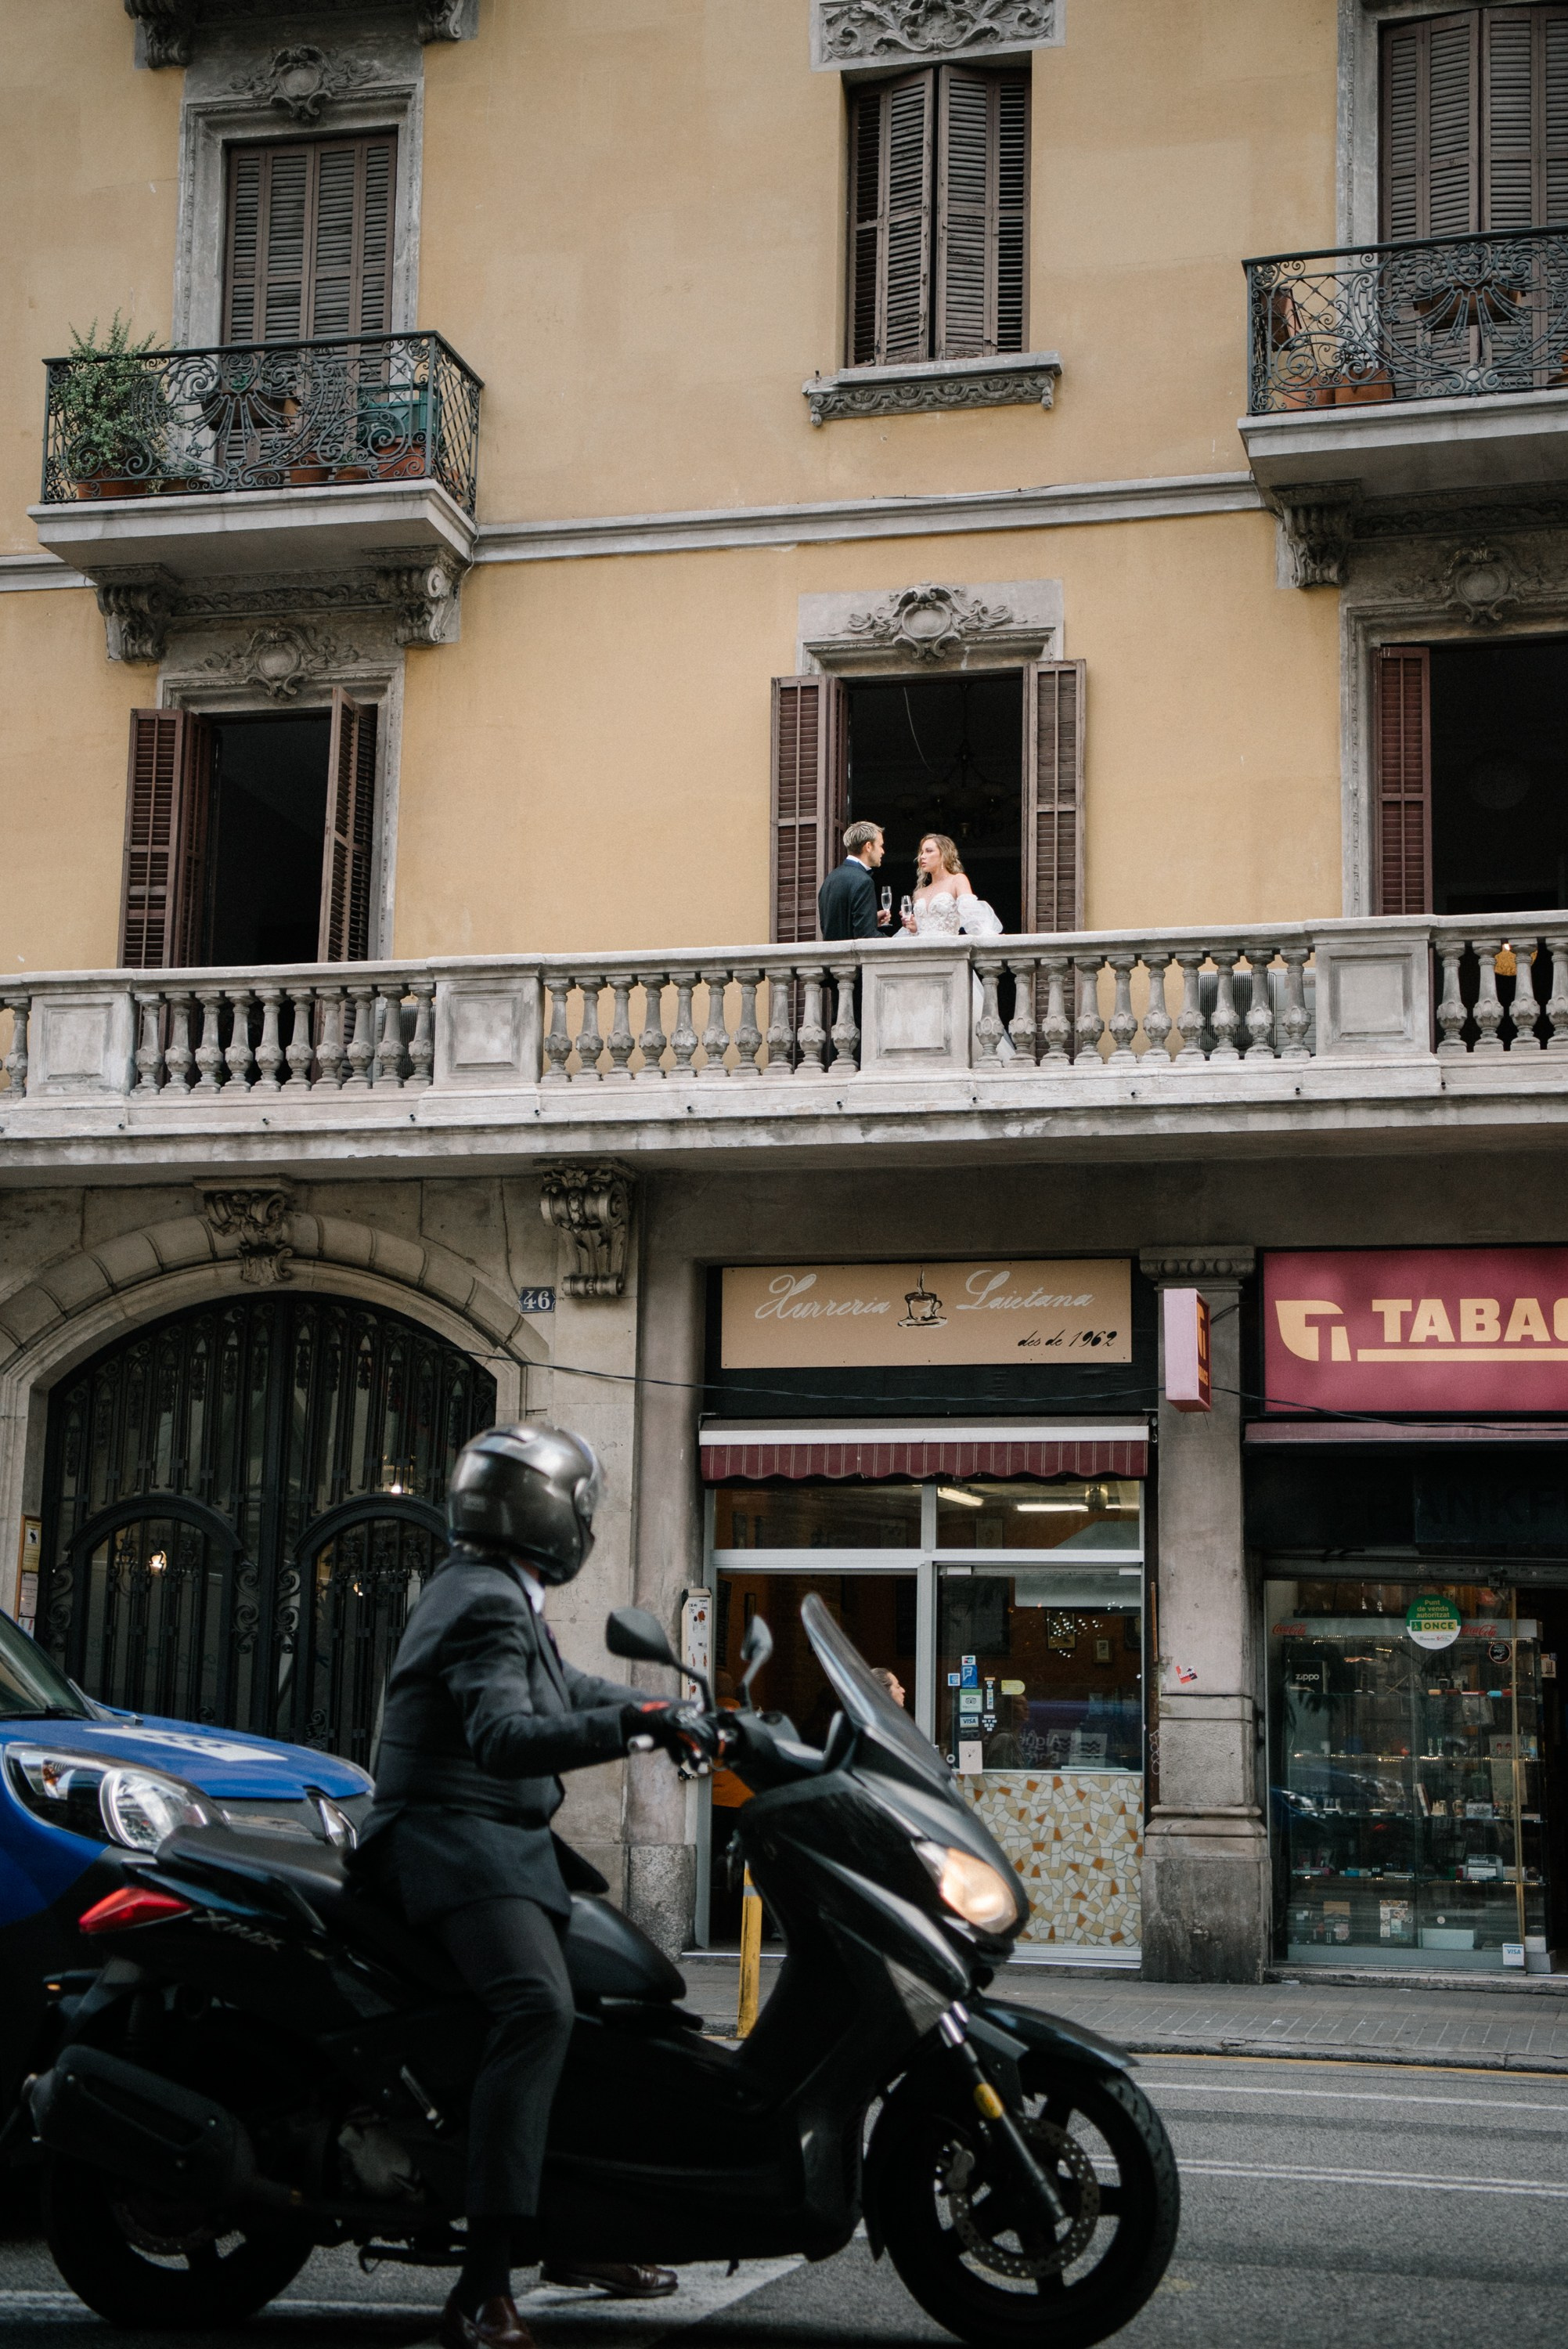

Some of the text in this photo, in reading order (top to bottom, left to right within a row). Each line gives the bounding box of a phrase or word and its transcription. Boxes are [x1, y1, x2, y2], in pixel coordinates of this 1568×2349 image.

[956, 1269, 1095, 1310] Laietana
[523, 1290, 550, 1310] 46
[1069, 1330, 1118, 1347] 1962
